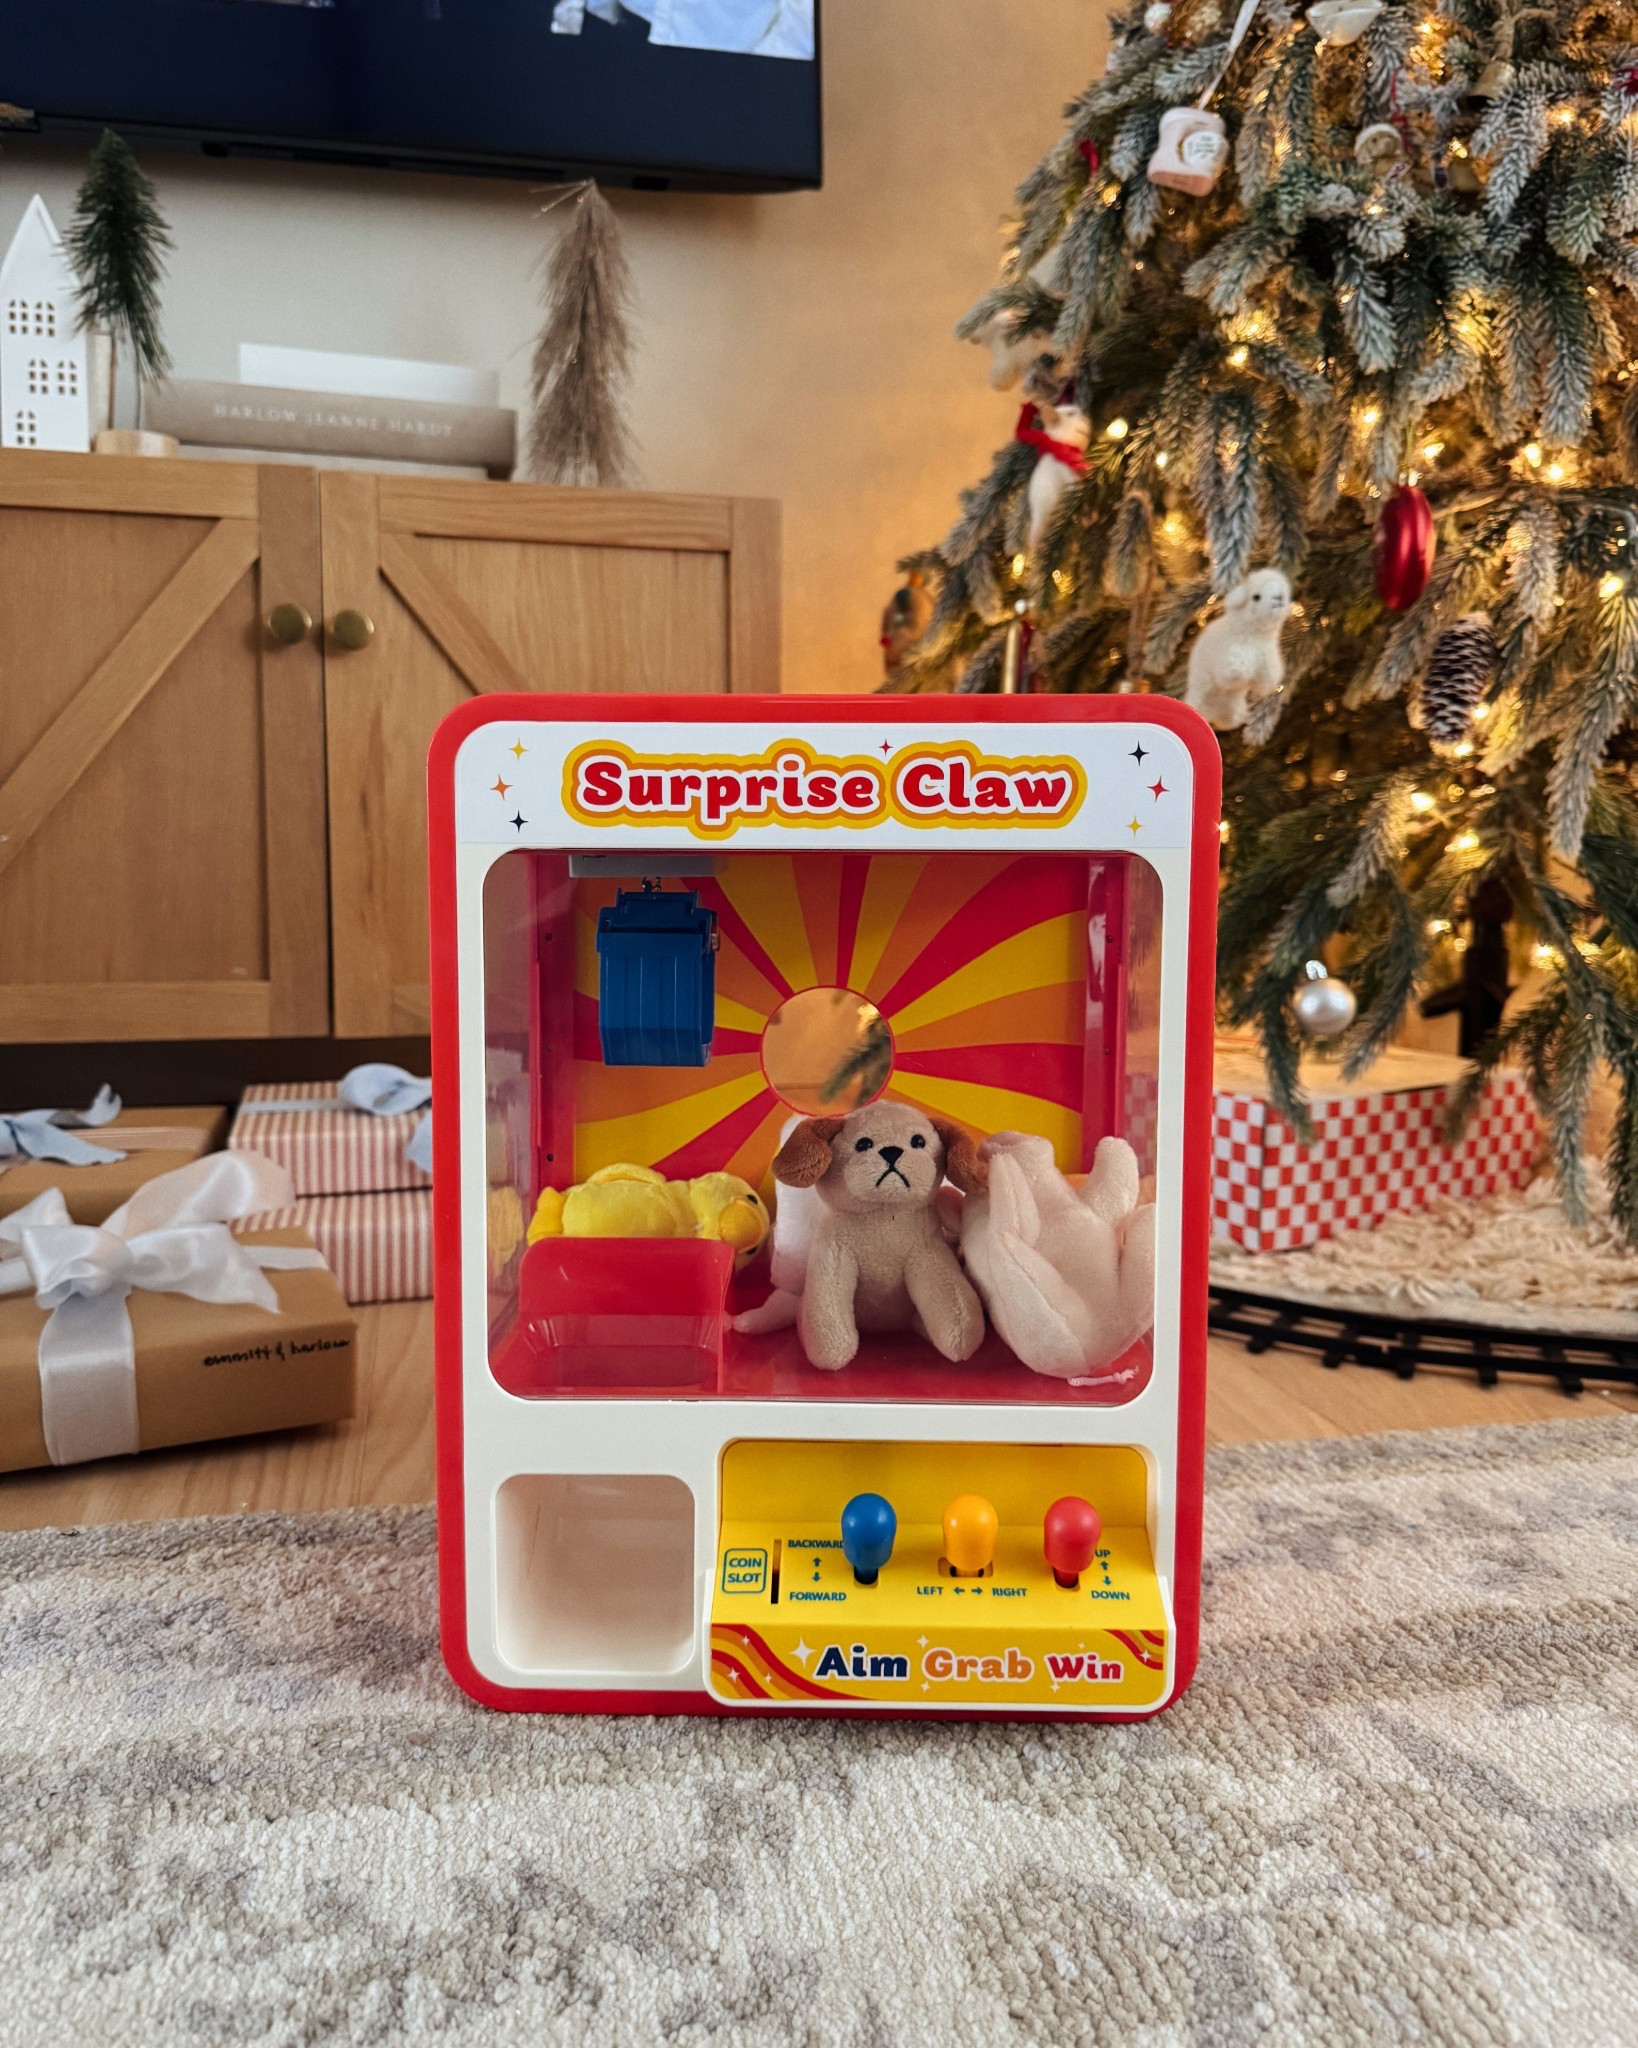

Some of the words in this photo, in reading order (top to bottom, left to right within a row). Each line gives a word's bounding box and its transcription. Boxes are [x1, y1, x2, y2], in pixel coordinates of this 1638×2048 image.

[582, 760, 879, 819] Surprise
[902, 762, 1066, 808] Claw
[291, 1339, 349, 1355] harlow
[1095, 1550, 1111, 1558] UP
[729, 1558, 762, 1568] COIN
[727, 1573, 762, 1583] SLOT
[789, 1592, 847, 1601] FORWARD
[916, 1586, 943, 1595] LEFT
[992, 1587, 1027, 1597] RIGHT
[1091, 1590, 1130, 1600] DOWN
[816, 1645, 908, 1678] Aim
[924, 1649, 1032, 1679] Grab
[1048, 1654, 1121, 1680] Win
